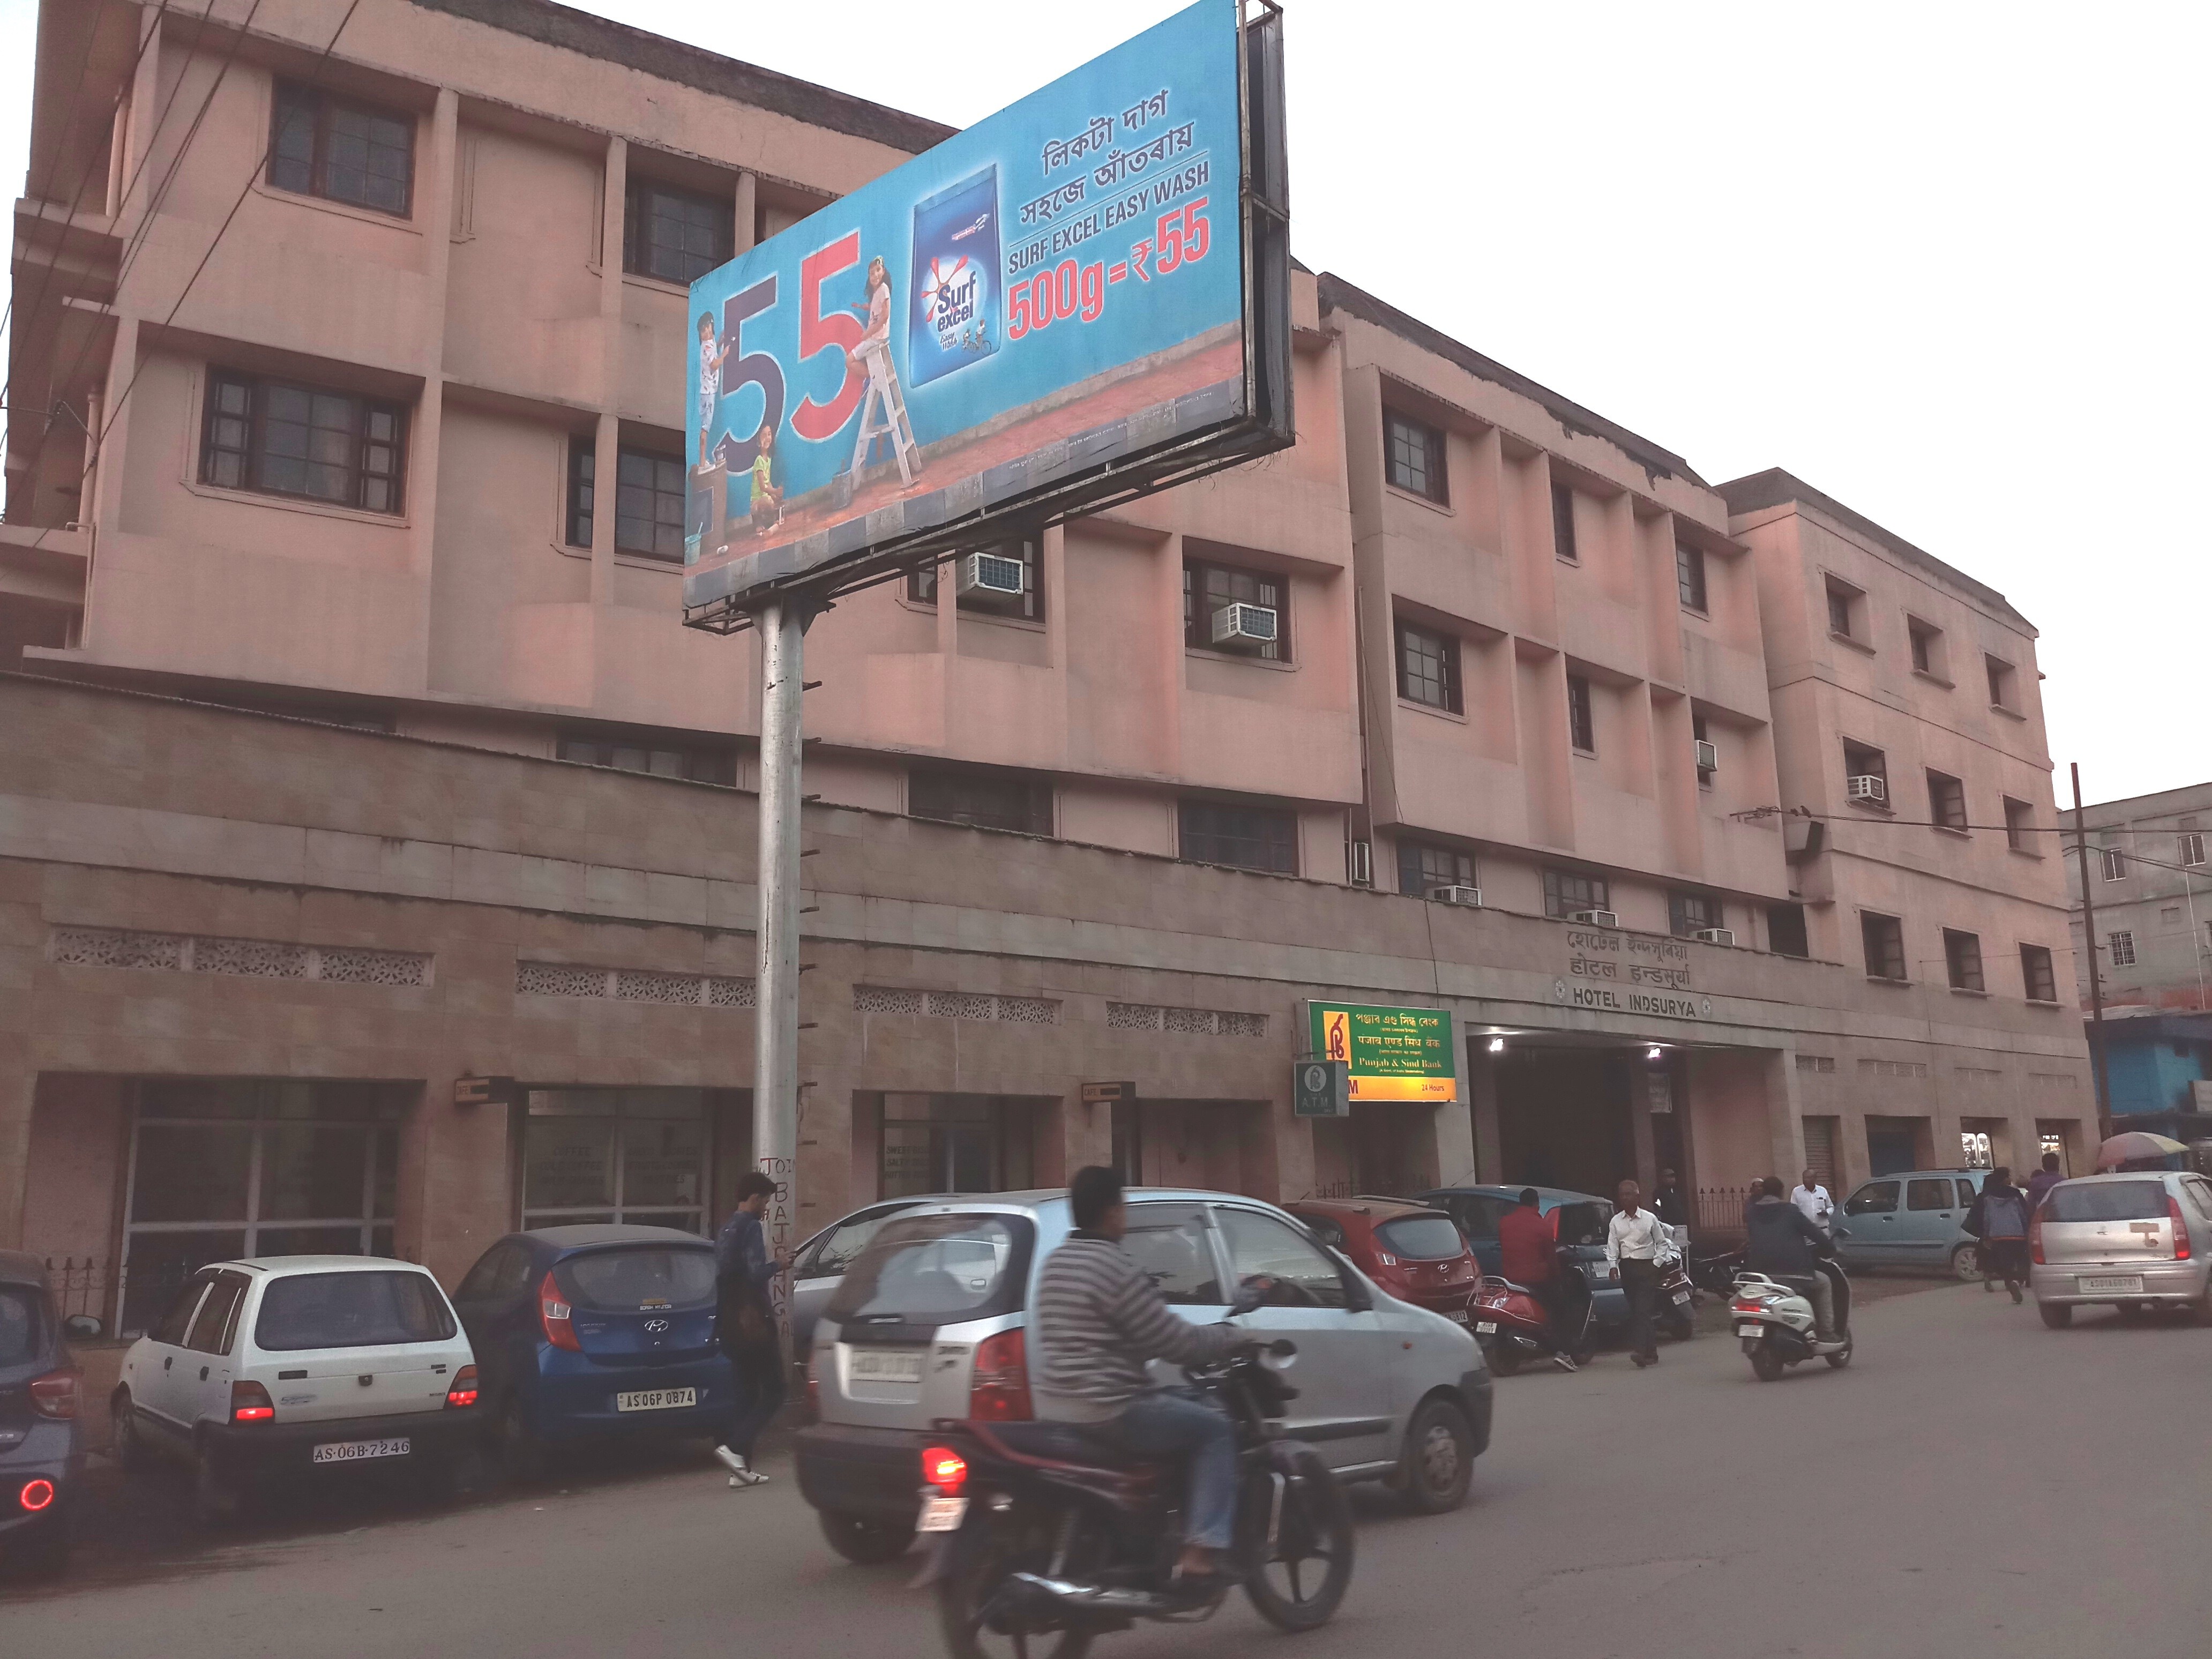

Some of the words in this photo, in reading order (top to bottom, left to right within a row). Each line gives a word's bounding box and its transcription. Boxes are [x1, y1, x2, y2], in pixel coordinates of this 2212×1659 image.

[1123, 89, 1168, 130] দাগ
[1020, 175, 1086, 224] সহজে
[1009, 241, 1048, 275] SURF
[1052, 221, 1101, 254] EXCEL
[1105, 193, 1147, 229] EASY
[1154, 161, 1208, 204] WASH
[938, 271, 976, 315] Surf
[938, 299, 973, 332] excel
[1567, 930, 1619, 951] হোটেল
[1570, 952, 1617, 977] होटल
[1573, 988, 1620, 1008] HOTEL
[1630, 994, 1696, 1017] INDSURYA
[1384, 1037, 1402, 1048] एण्ड
[1359, 1057, 1389, 1068] Punjab
[1392, 1058, 1399, 1067] &
[1401, 1058, 1419, 1068] Sind
[1422, 1059, 1442, 1069] Bank
[886, 1146, 911, 1155] SWEET
